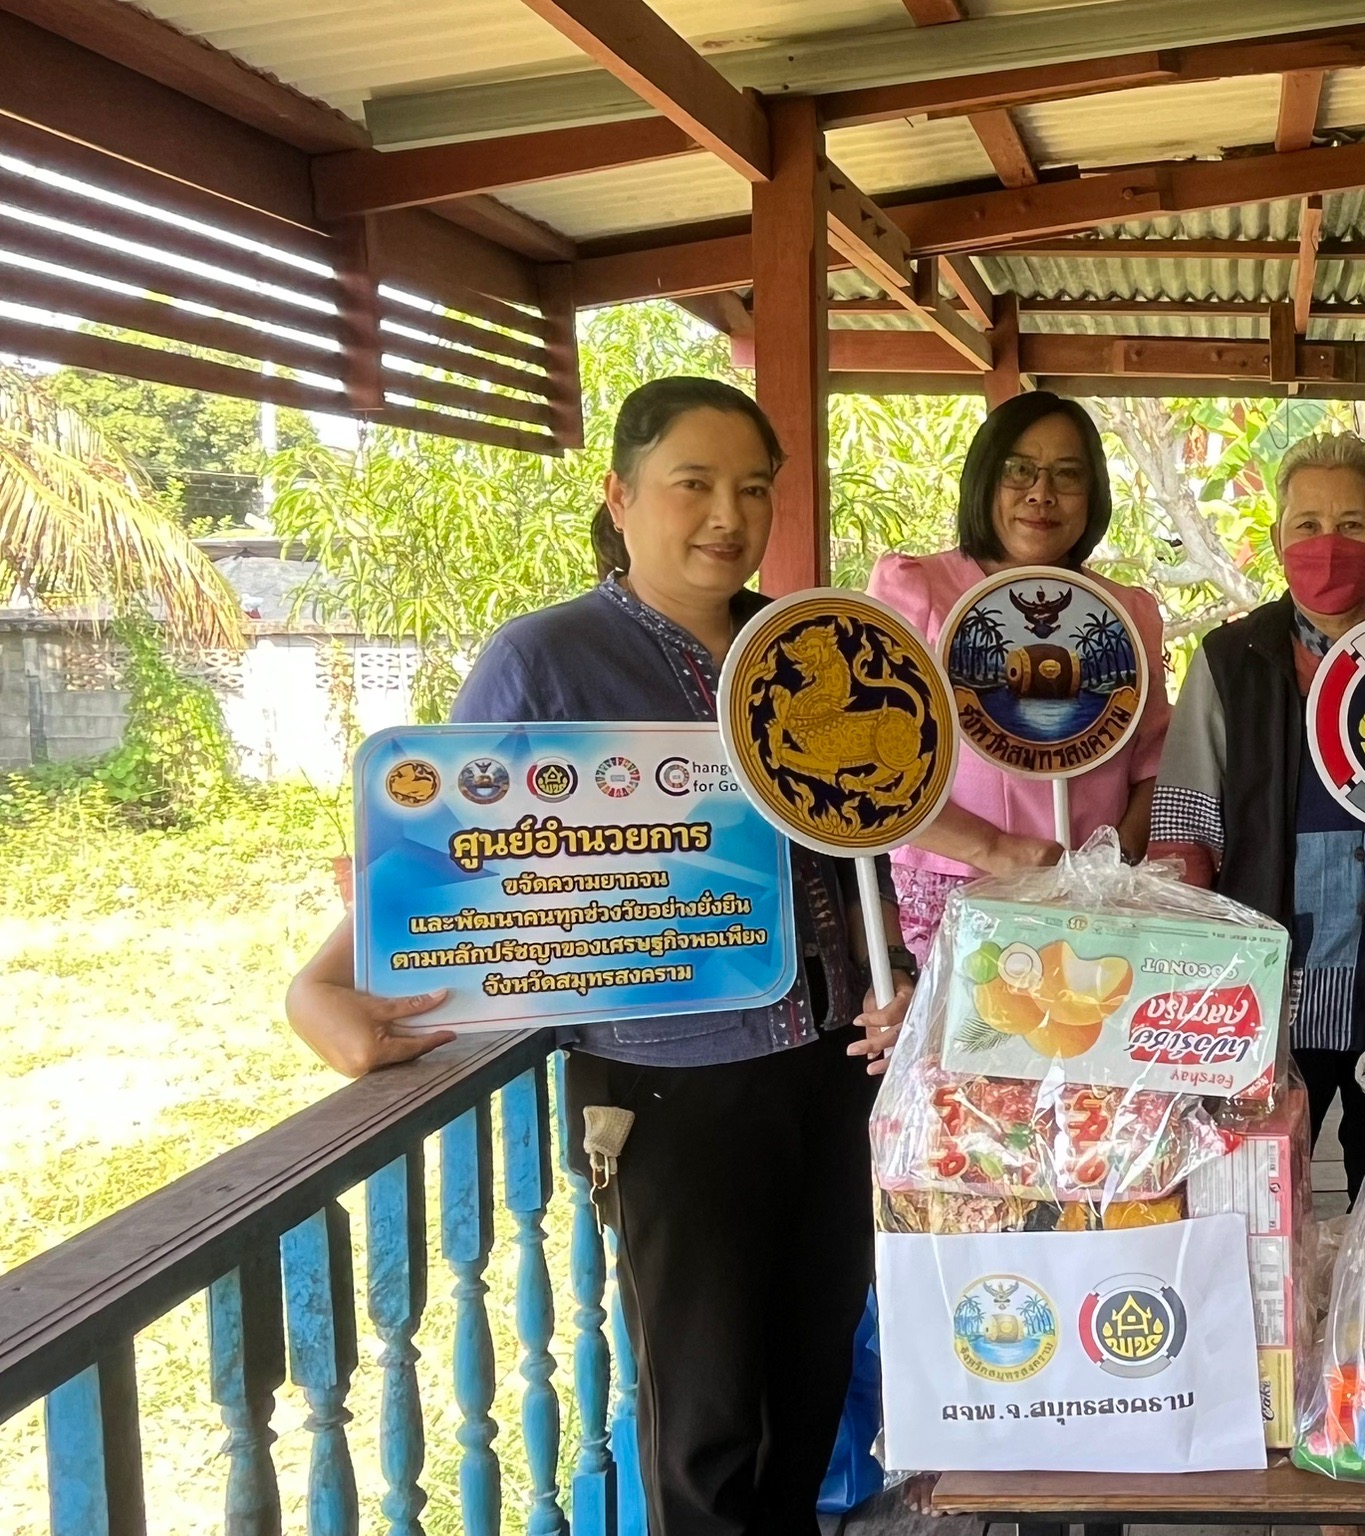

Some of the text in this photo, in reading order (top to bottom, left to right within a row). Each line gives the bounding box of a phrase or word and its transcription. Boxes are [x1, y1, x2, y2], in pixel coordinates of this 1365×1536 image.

[693, 780, 714, 792] for
[452, 814, 709, 869] ศูนย์อำนวยการ
[503, 870, 669, 895] ขจัดความยากจน
[410, 890, 751, 934] และพัฒนาคนทุกช่วงวัยอย่างยั่งยืน
[391, 926, 767, 970] ตามหลักปรัชญาของเศรษฐกิจพอเพียง
[483, 964, 693, 997] จังหวัดสมุทรสงคราม
[1140, 957, 1240, 980] COCONUT
[1169, 1068, 1235, 1089] Fershay
